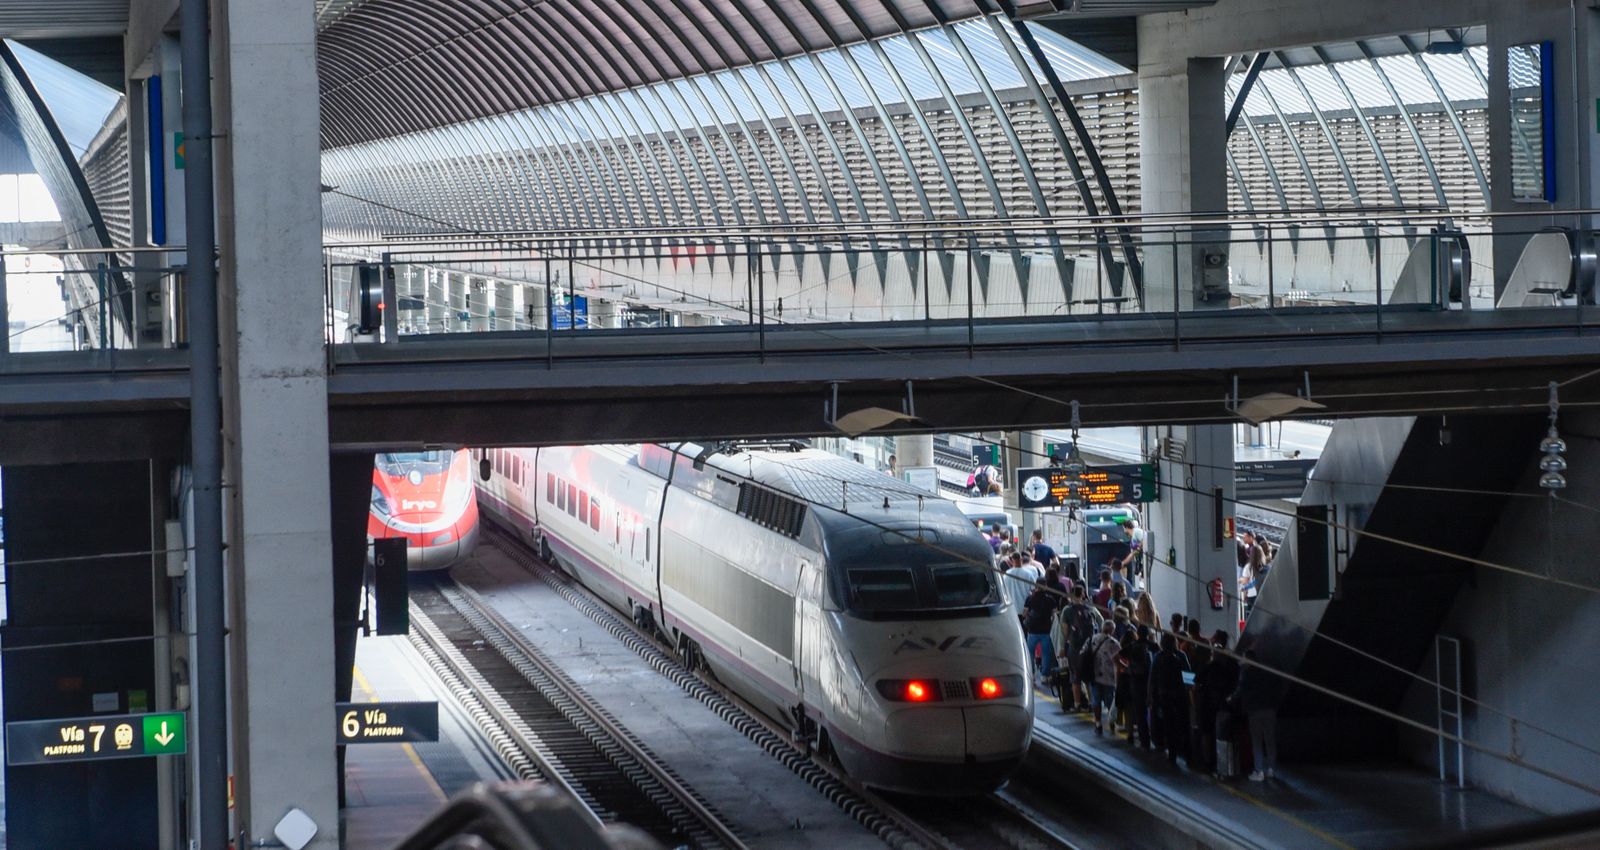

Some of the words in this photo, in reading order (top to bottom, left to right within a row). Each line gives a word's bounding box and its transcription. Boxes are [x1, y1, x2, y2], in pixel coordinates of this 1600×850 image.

[973, 455, 981, 466] 5
[1132, 483, 1143, 500] 5
[402, 498, 437, 511] iryo
[376, 553, 385, 568] 6
[892, 634, 994, 656] AVE
[342, 710, 360, 738] 6
[364, 708, 387, 725] Vía
[60, 725, 85, 742] Vía
[88, 725, 105, 752] 7
[363, 726, 404, 737] PLATFORM
[43, 744, 85, 756] PLATFORM
